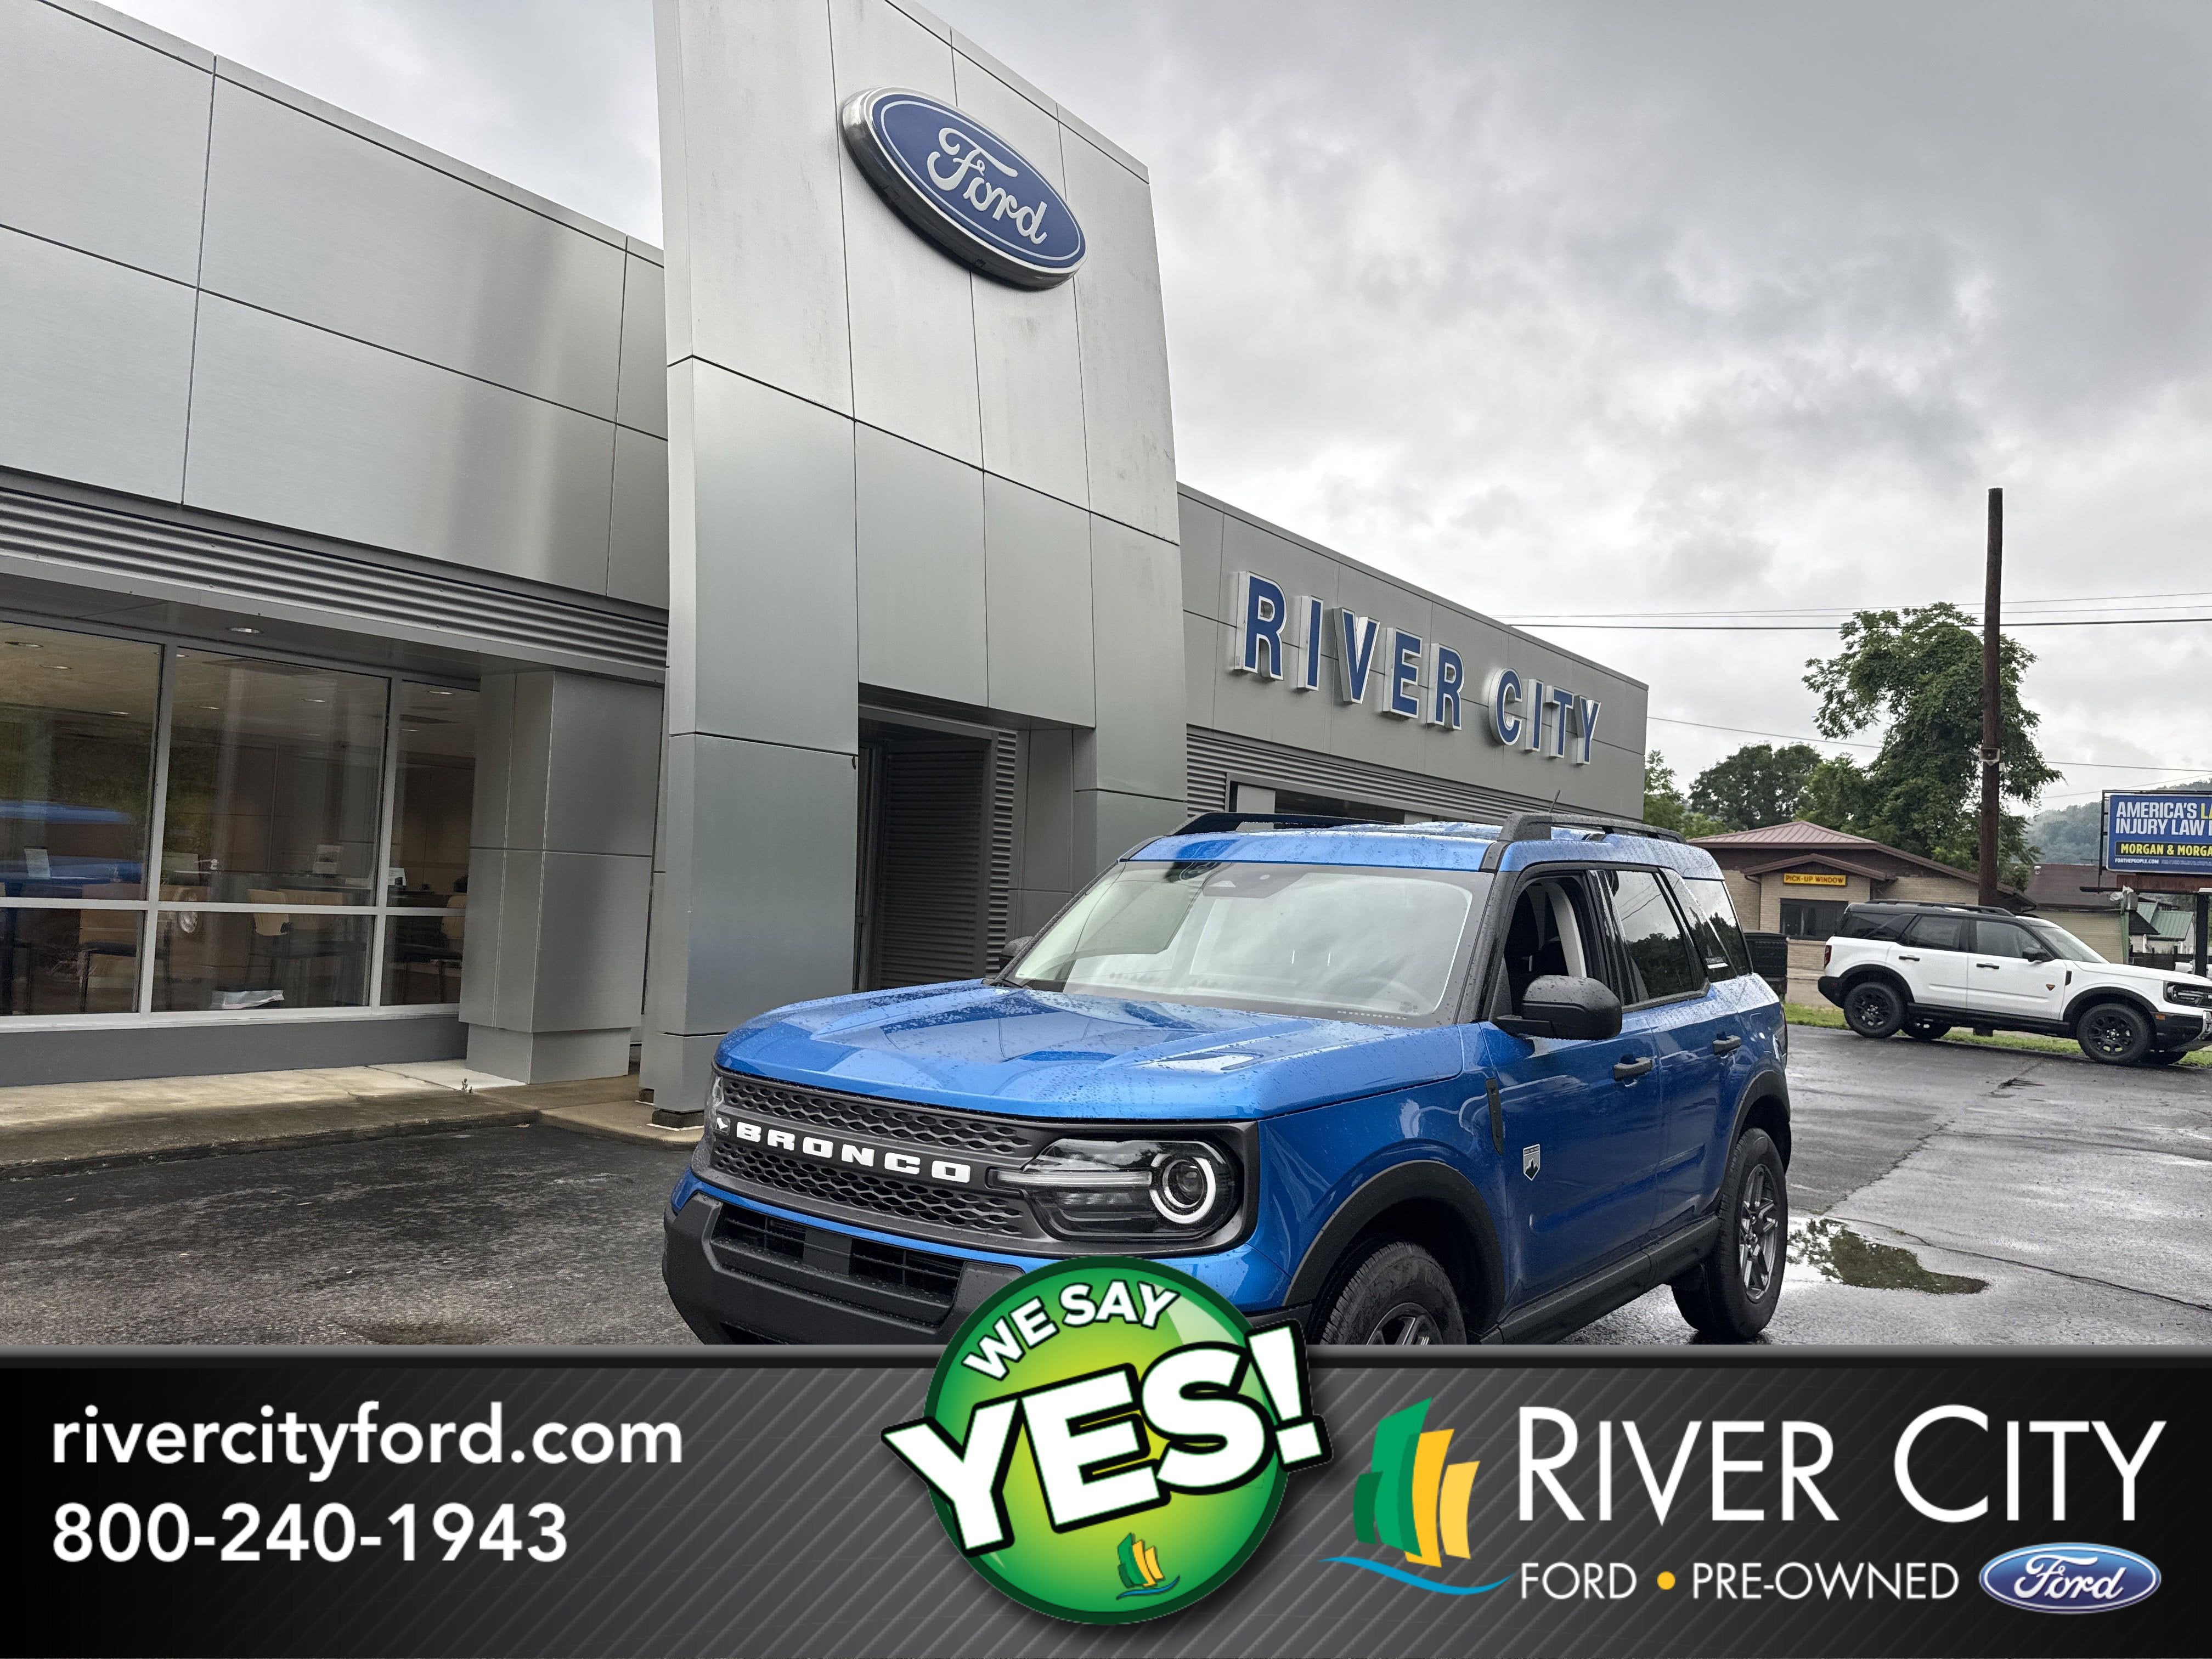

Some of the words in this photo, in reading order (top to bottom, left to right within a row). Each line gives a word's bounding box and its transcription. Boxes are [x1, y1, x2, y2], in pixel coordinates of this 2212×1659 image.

[927, 127, 1047, 244] Ford
[1234, 571, 1465, 730] RIVER
[1489, 668, 1601, 765] CITY
[2115, 818, 2168, 834] INJURY
[2171, 820, 2205, 836] LAW
[2116, 802, 2197, 819] AMERICA'S
[2120, 843, 2164, 855] MORGAN
[2166, 844, 2175, 855] &
[736, 1121, 970, 1183] BRONCO
